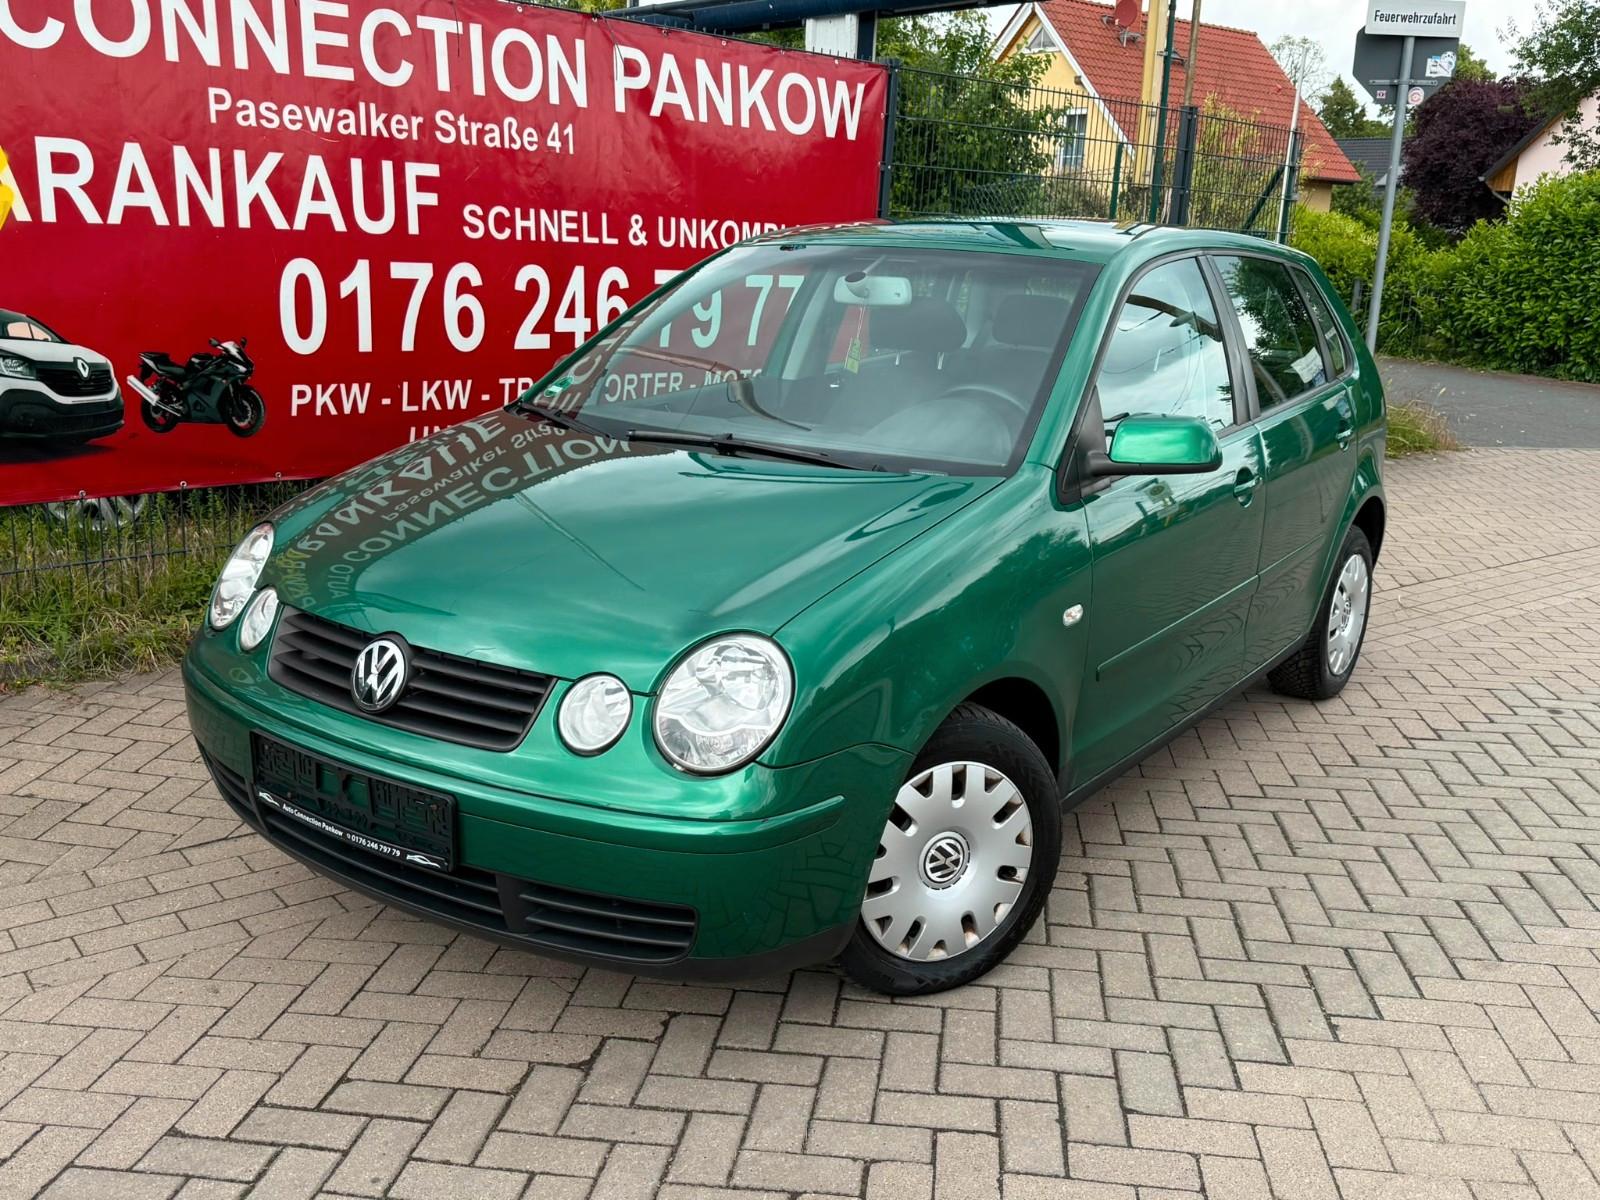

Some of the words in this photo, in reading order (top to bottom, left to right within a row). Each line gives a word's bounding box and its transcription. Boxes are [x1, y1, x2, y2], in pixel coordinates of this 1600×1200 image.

[1374, 9, 1457, 25] Feuerwehrzufahrt
[614, 44, 866, 141] PANKOW
[207, 86, 424, 142] Pasewalker
[434, 109, 539, 152] Straße
[547, 123, 576, 154] 41
[462, 203, 618, 245] SCHNELL
[628, 213, 648, 246] &
[279, 257, 486, 355] 0176
[514, 263, 631, 350] 246
[291, 382, 372, 417] PKW
[401, 379, 472, 412] LKW
[282, 803, 294, 814] Auto
[294, 809, 322, 827] Connection
[322, 822, 343, 837] Pankow
[351, 835, 366, 846] 0176
[367, 840, 379, 850] 246
[380, 844, 391, 855] 797
[392, 848, 401, 857] 79
